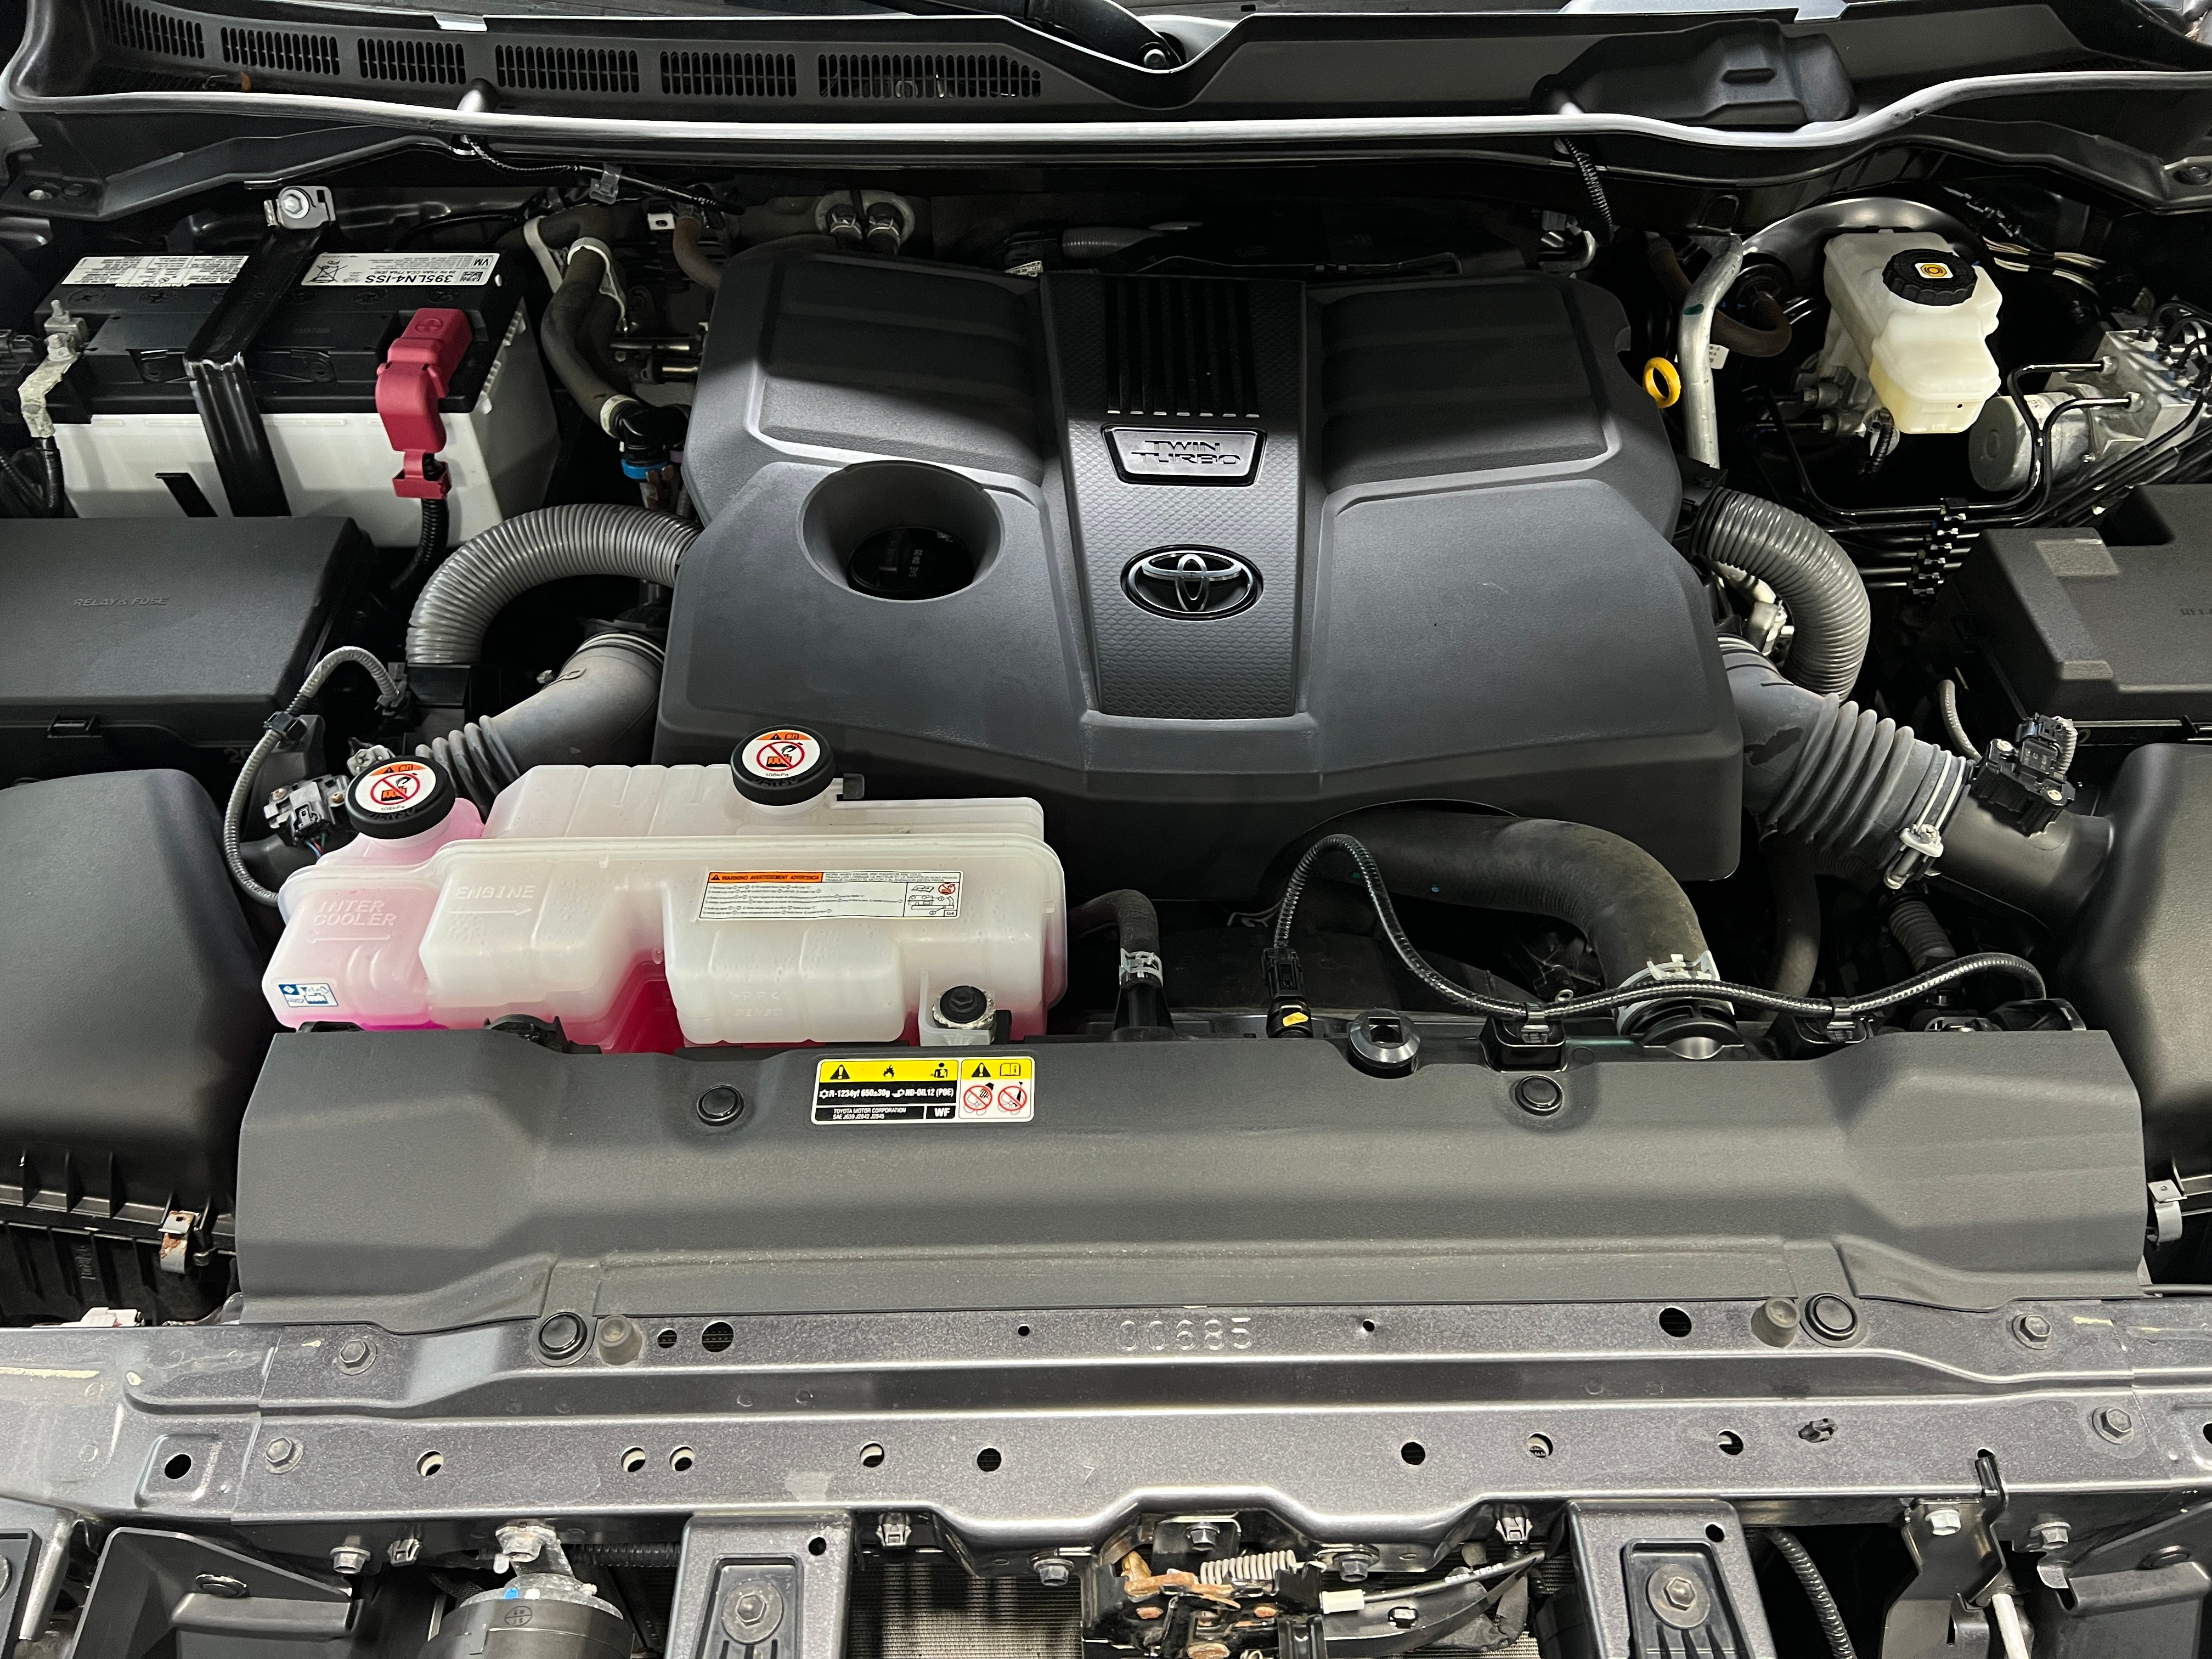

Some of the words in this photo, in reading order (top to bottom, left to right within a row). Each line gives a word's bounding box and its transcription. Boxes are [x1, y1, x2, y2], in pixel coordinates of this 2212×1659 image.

[365, 275, 453, 283] 395LN4-ISS
[1145, 441, 1220, 452] TWIN
[1131, 452, 1241, 464] TURBO
[912, 550, 923, 564] 0W-20
[909, 567, 918, 577] SAE
[74, 598, 119, 607] RELAY
[131, 597, 169, 606] FUSE
[455, 885, 535, 899] ENGINE
[320, 900, 385, 912] INTER
[314, 912, 397, 926] COOLER
[828, 1089, 860, 1098] R-1234yf
[936, 1088, 954, 1097] (POE)
[934, 1107, 950, 1118] WF
